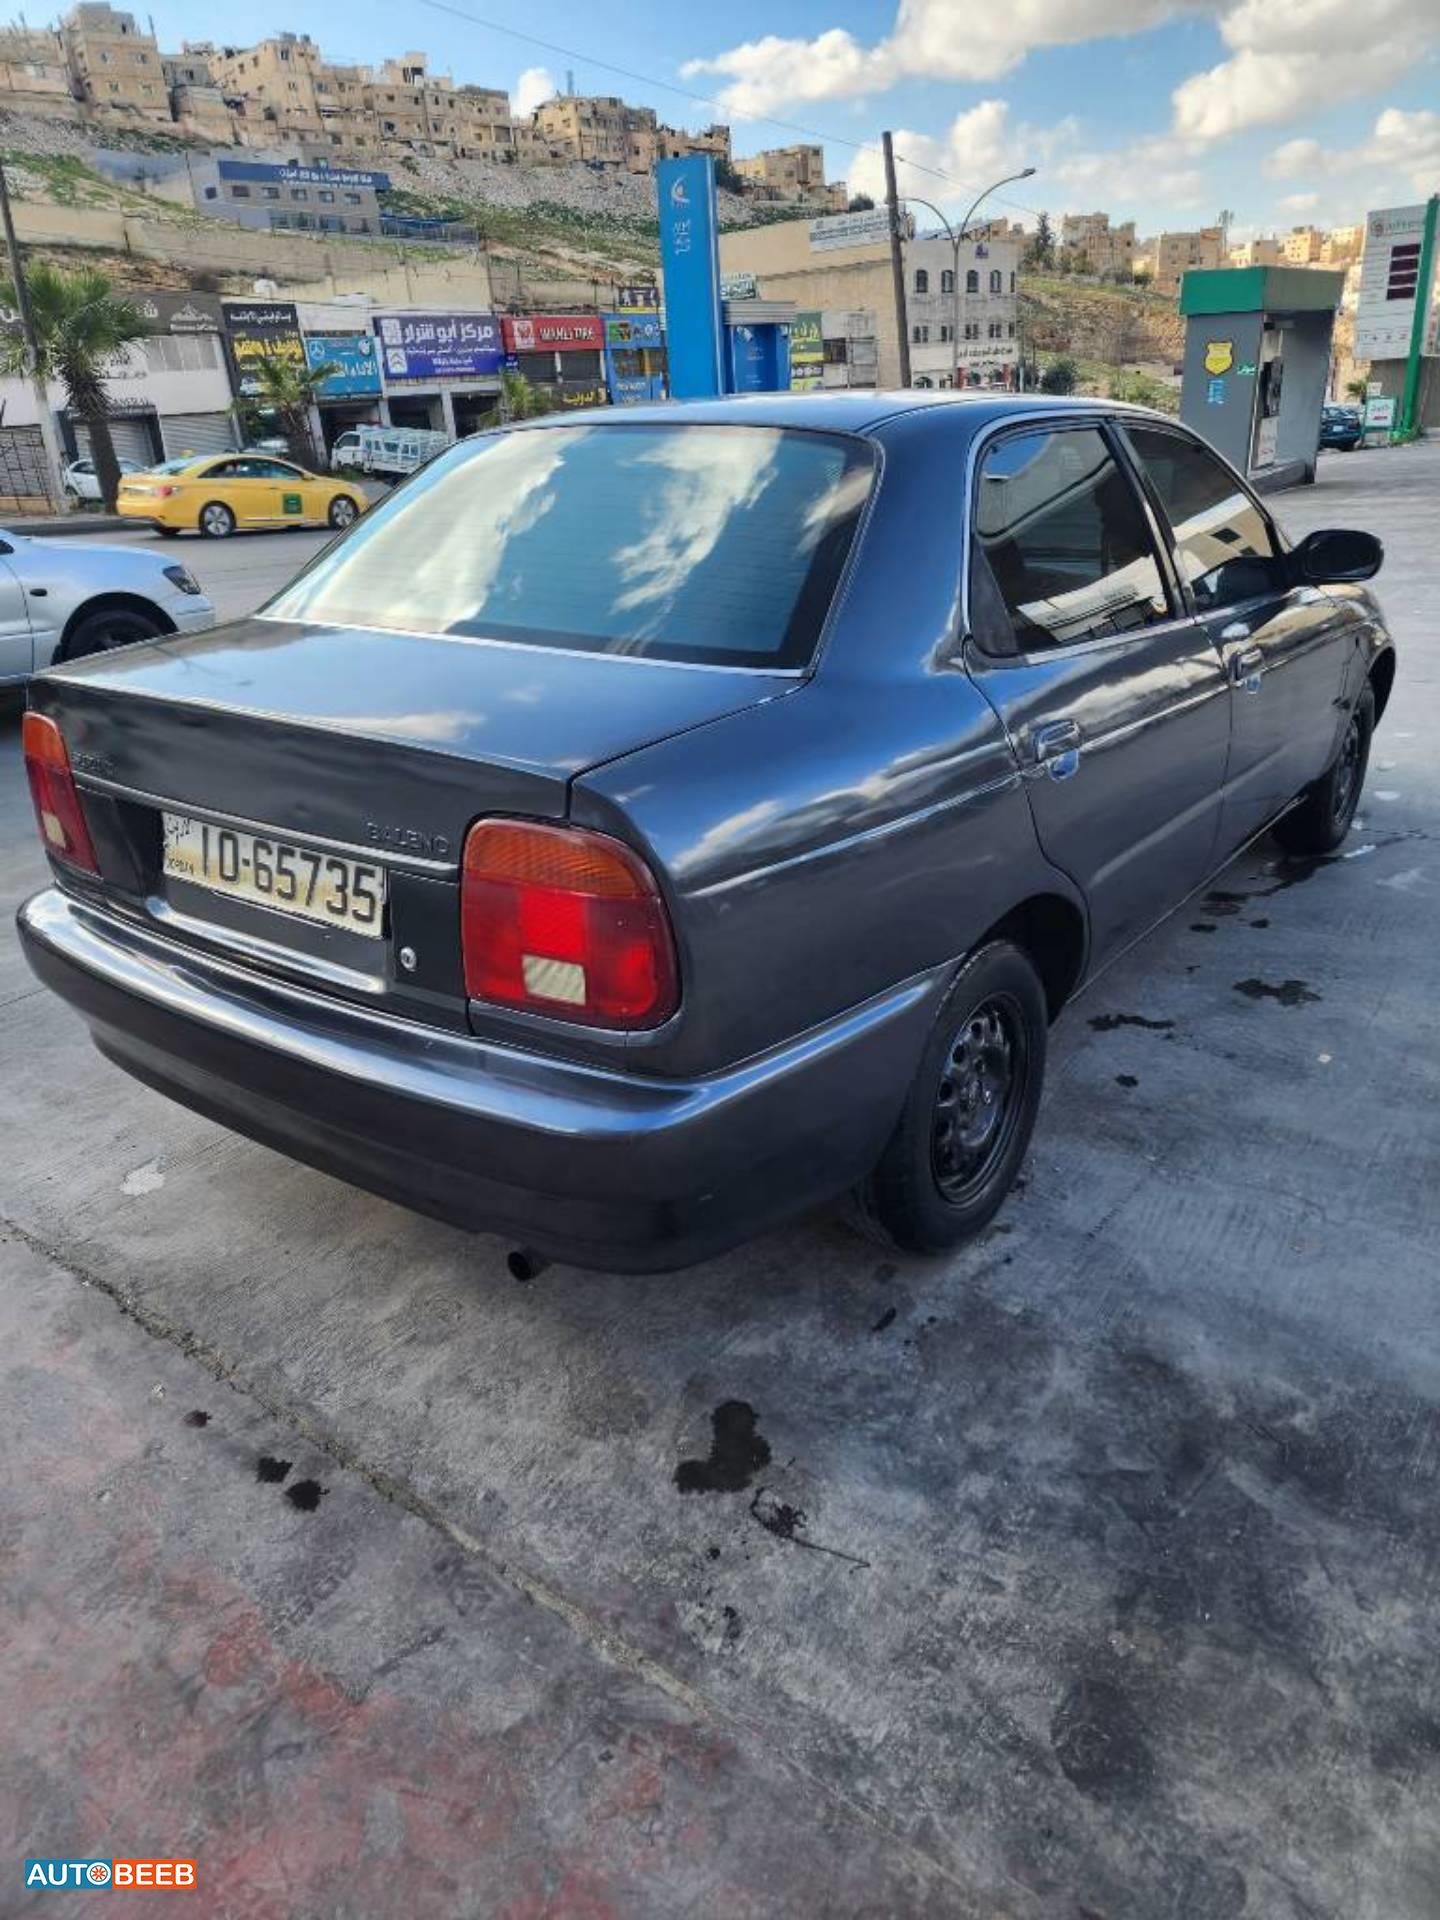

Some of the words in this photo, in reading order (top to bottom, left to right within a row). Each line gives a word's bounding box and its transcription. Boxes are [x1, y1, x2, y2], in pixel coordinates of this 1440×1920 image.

[436, 319, 457, 342] أبو
[460, 323, 493, 342] مركز
[202, 824, 376, 923] 10-65735
